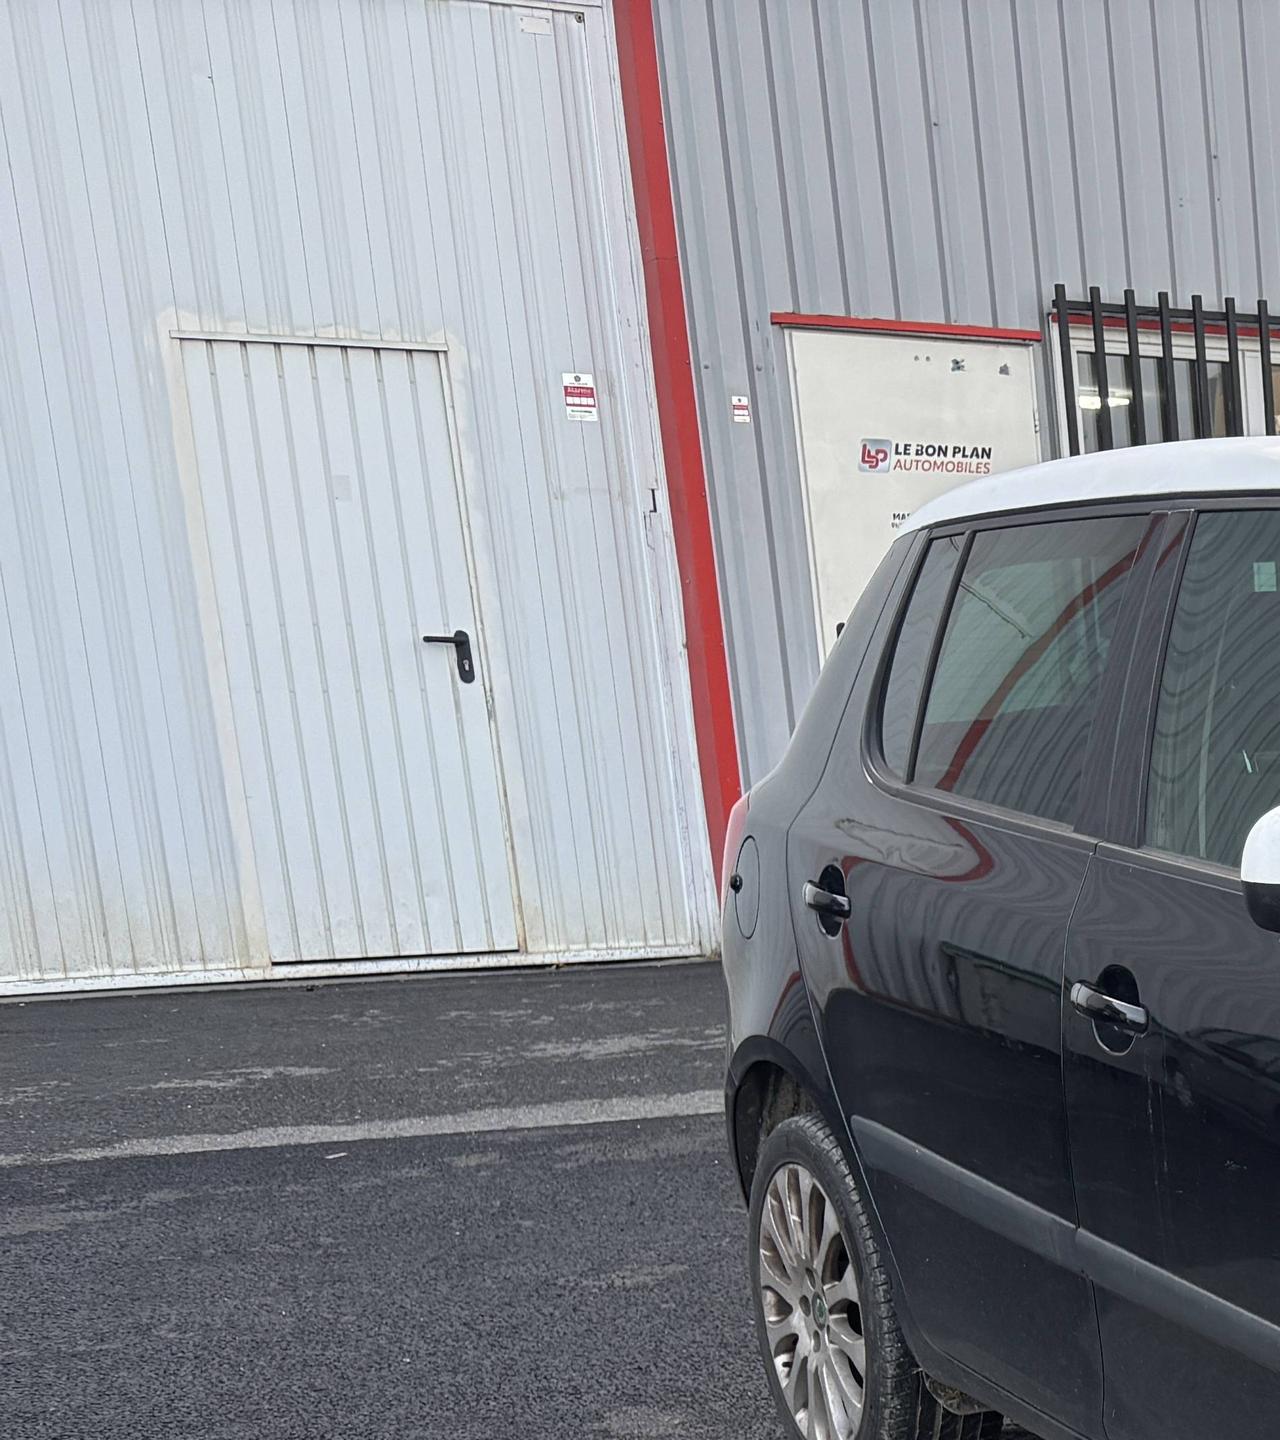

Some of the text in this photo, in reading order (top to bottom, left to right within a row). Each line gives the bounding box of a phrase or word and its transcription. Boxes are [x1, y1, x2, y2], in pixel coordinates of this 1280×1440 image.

[895, 443, 992, 460] LE BON PLAN
[893, 459, 991, 474] AUTOMOBILES
